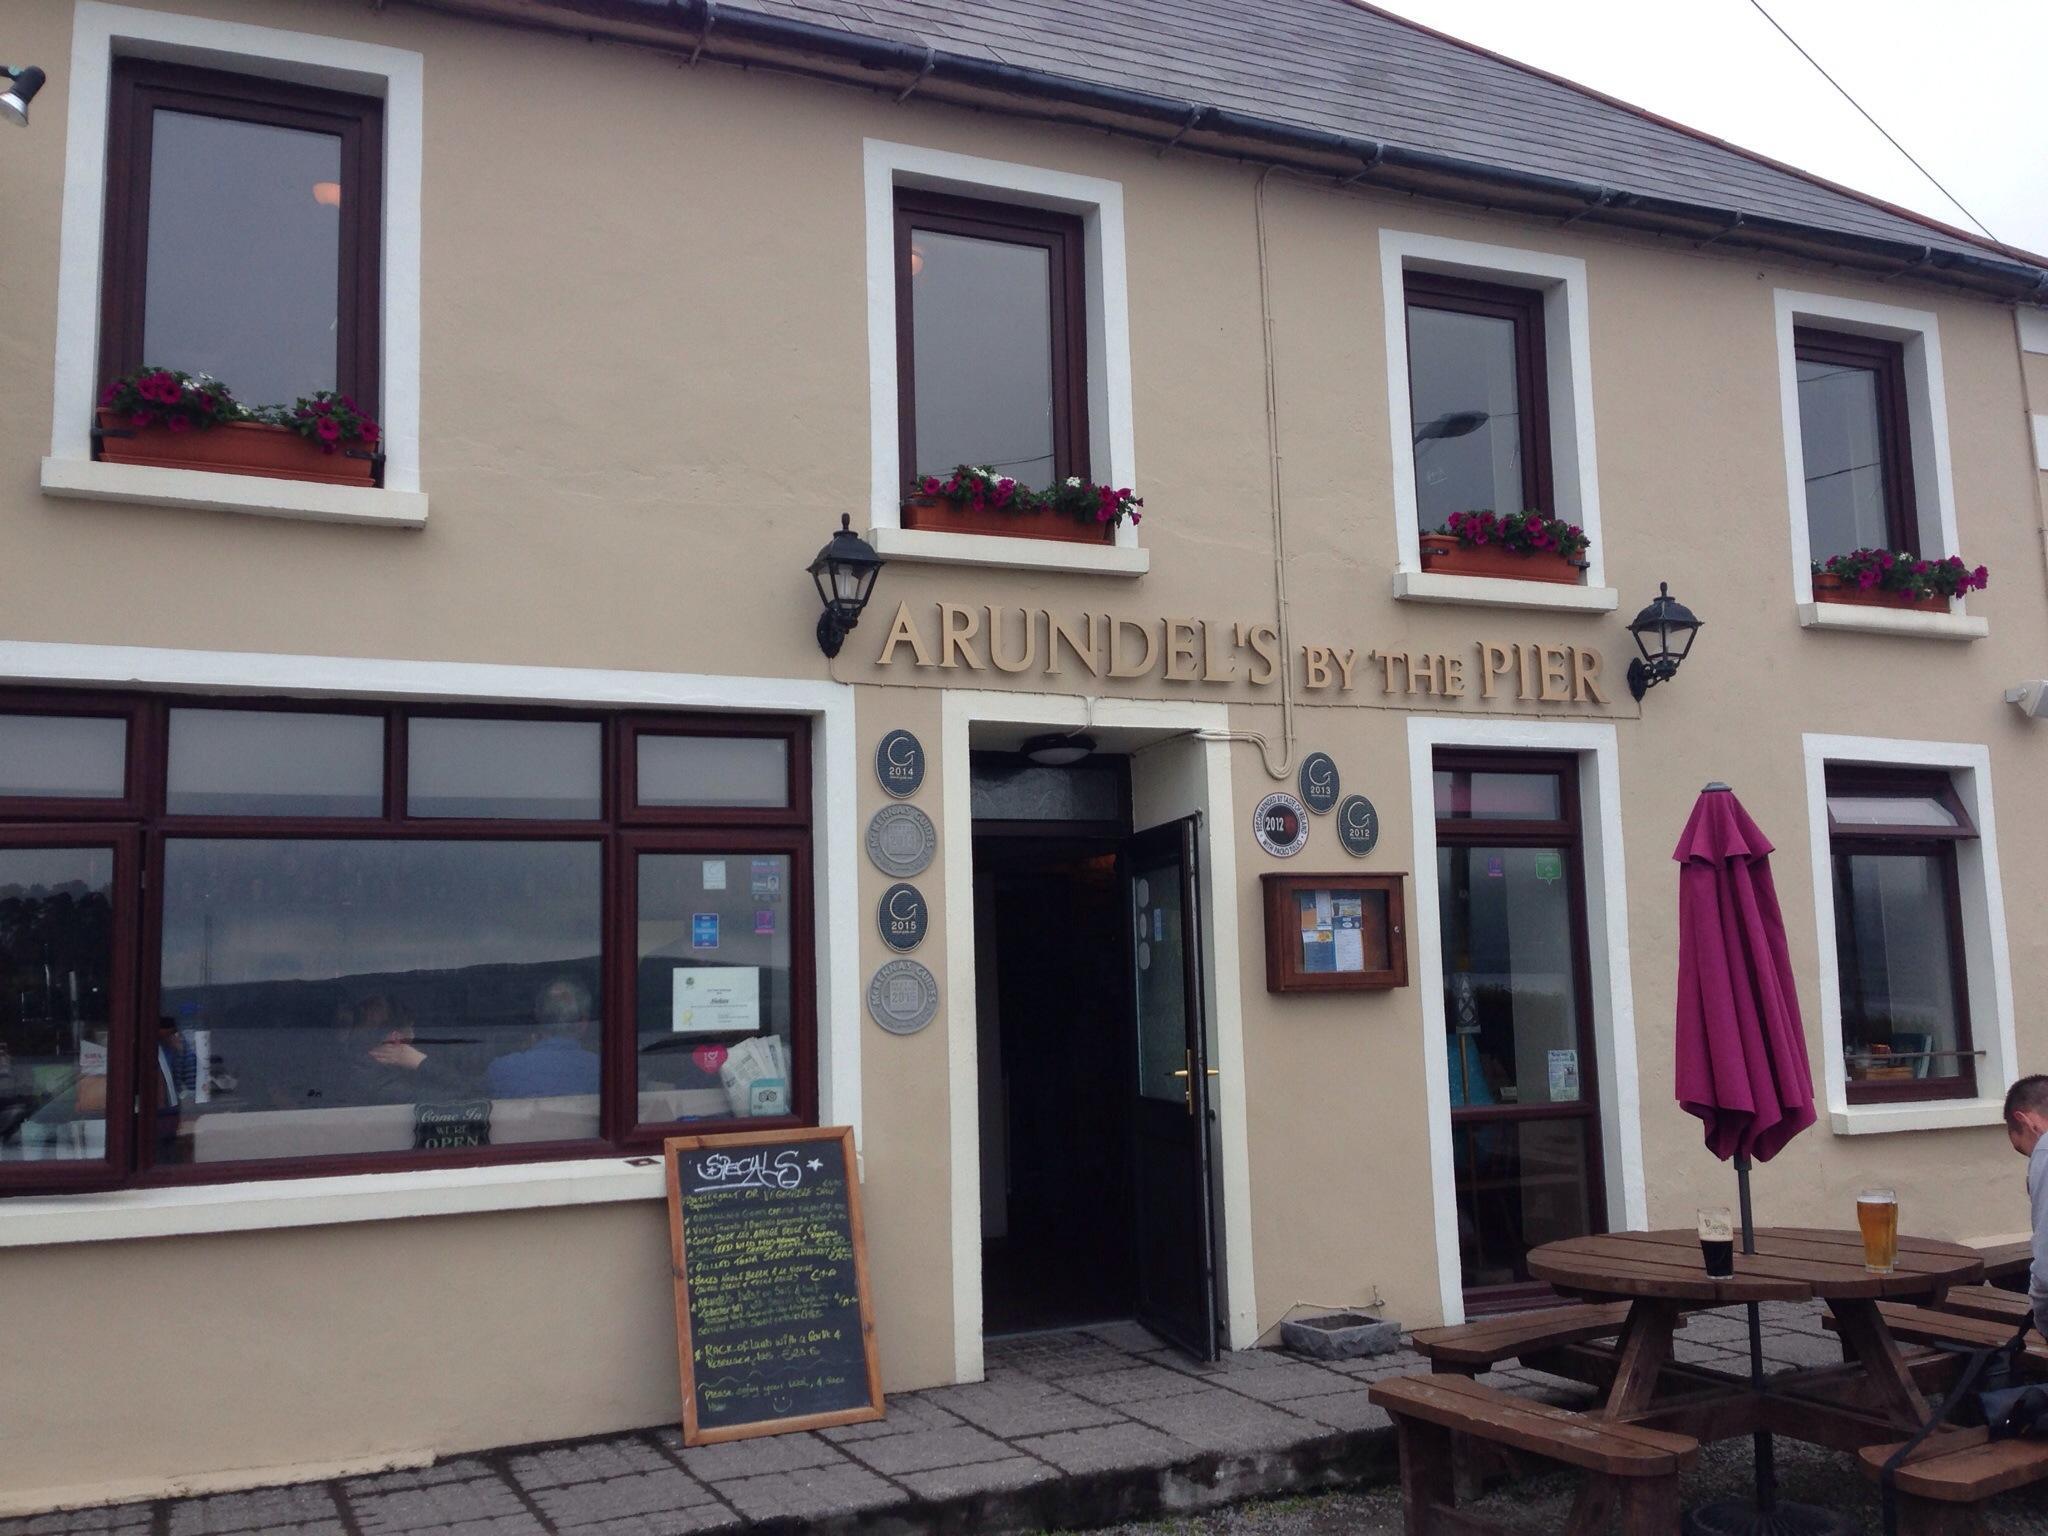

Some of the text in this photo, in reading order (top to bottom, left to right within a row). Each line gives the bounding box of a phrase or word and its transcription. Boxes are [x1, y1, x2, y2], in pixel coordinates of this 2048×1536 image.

[876, 600, 1611, 703] ARUNDEL'S BY THE PIER
[889, 767, 913, 775] 2014
[1310, 785, 1331, 794] 2013
[1265, 817, 1285, 832] 2012
[1349, 828, 1370, 837] 2012
[891, 920, 917, 930] 2015
[421, 1107, 482, 1122] Come In
[425, 1136, 479, 1149] OPEN
